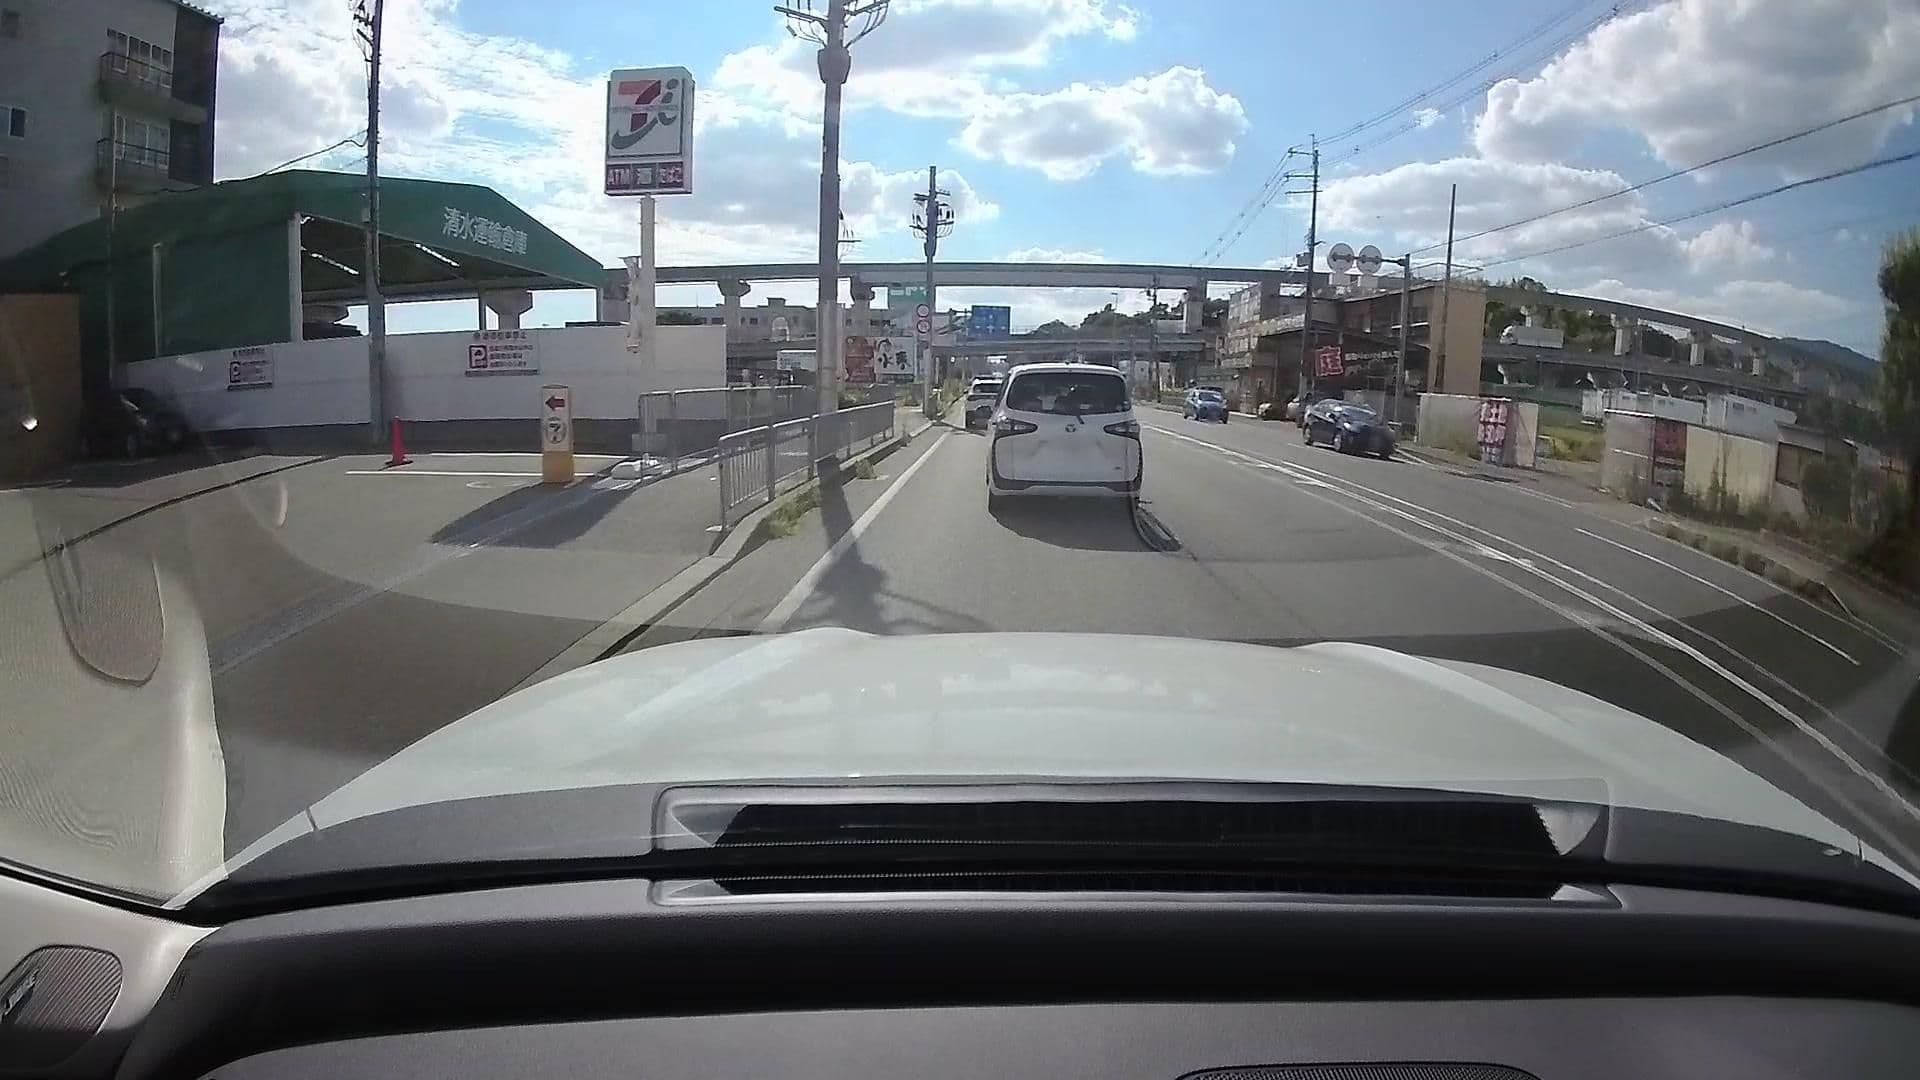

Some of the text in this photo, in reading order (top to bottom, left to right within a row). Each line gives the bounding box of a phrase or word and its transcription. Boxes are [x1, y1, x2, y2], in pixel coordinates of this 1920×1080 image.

[606, 168, 630, 185] ATM
[442, 206, 528, 255] 清水運輸倉庫
